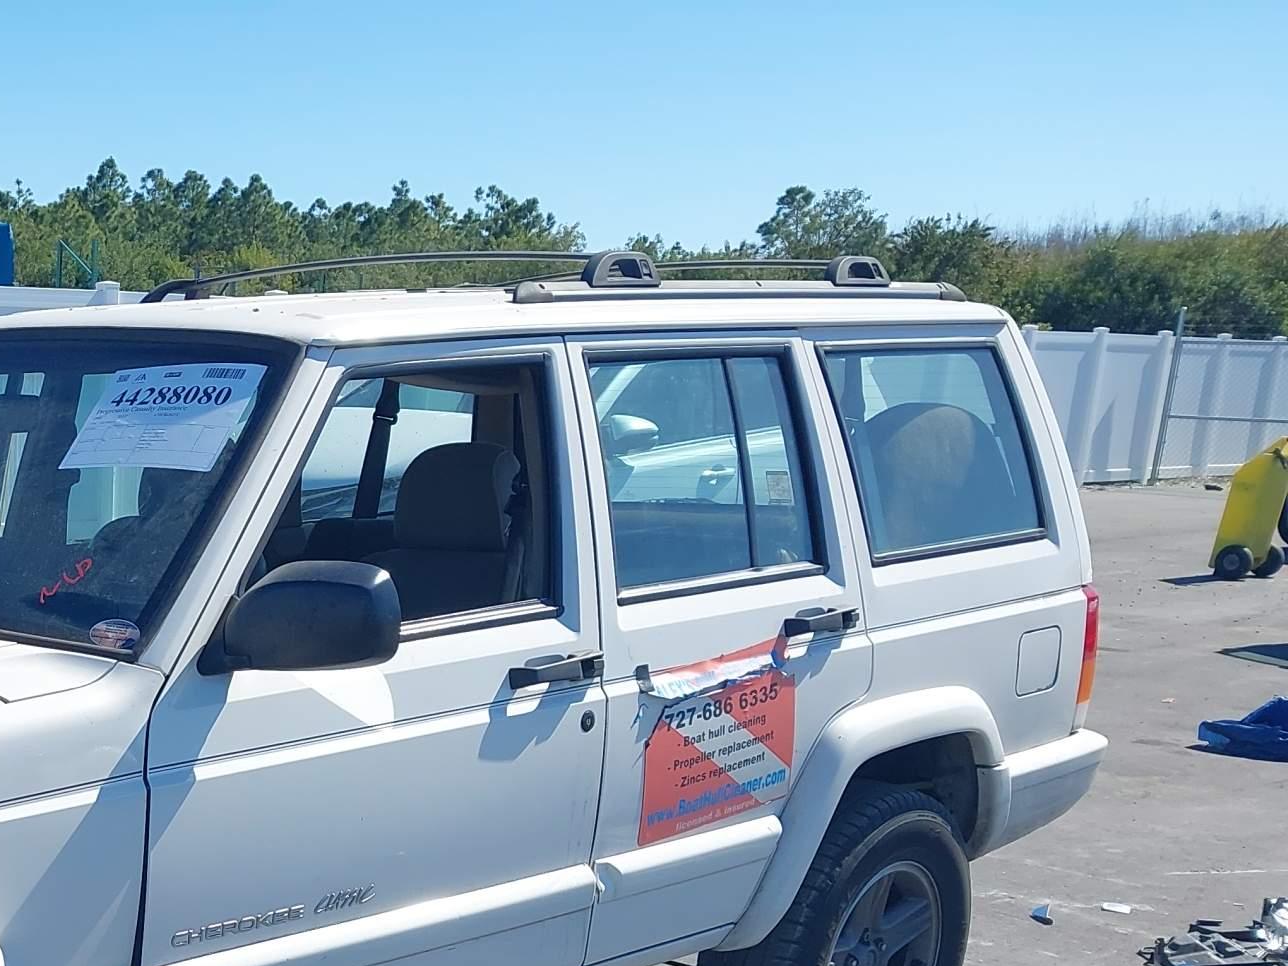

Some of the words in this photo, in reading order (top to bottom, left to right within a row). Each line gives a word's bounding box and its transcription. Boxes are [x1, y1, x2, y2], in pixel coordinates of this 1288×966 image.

[111, 385, 232, 406] 44288080
[664, 697, 734, 731] 727-686
[740, 682, 779, 710] 6335
[683, 734, 706, 748] Boat
[708, 726, 725, 739] hull
[728, 714, 767, 735] cleaning
[674, 750, 716, 770] Propeller
[718, 731, 774, 757] replacement
[681, 771, 706, 787] Zincs
[709, 752, 765, 779] replacement
[647, 768, 786, 826] www.BoatHullCleaner.com
[676, 812, 713, 831] licensed
[724, 799, 755, 815] insured
[171, 904, 305, 948] CHEROKEE
